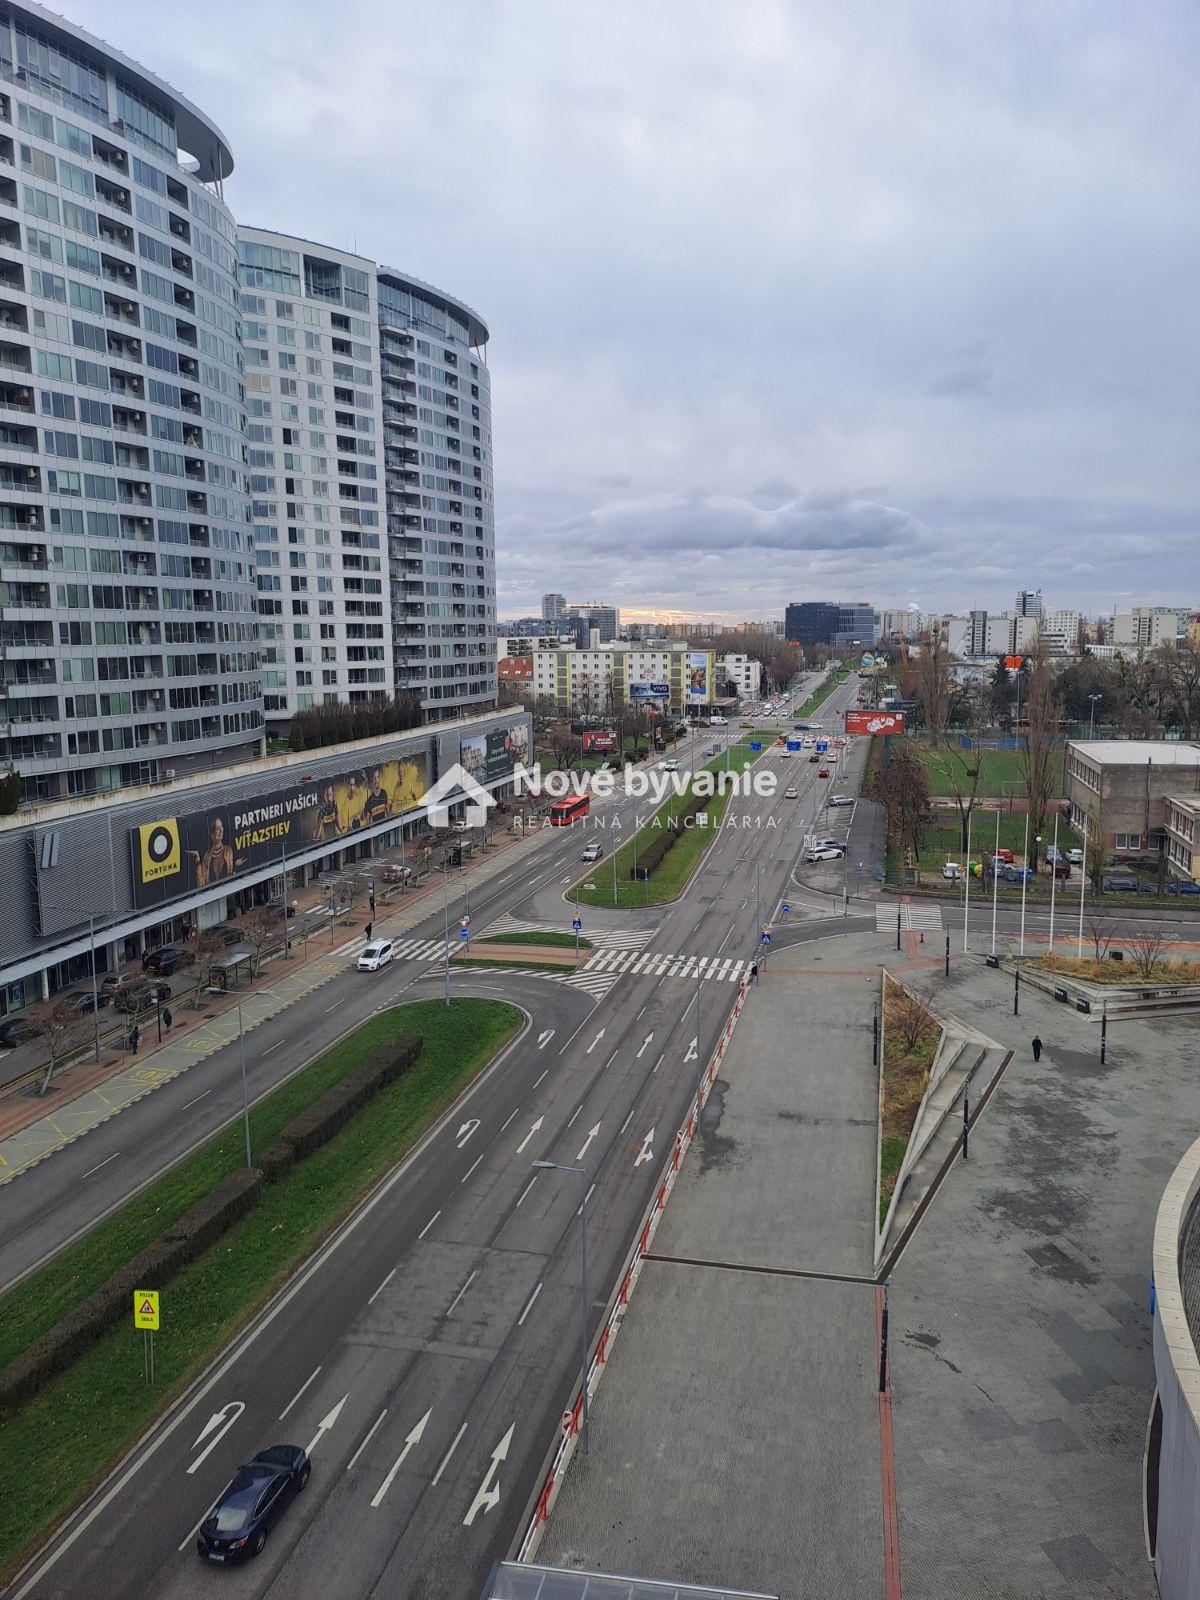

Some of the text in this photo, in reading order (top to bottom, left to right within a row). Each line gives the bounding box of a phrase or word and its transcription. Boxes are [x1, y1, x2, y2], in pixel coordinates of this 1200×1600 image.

[234, 793, 318, 830] PARTNERI VAŠICH
[234, 820, 291, 850] VÍŤAZSTIEV
[144, 862, 178, 878] FORTUNA
